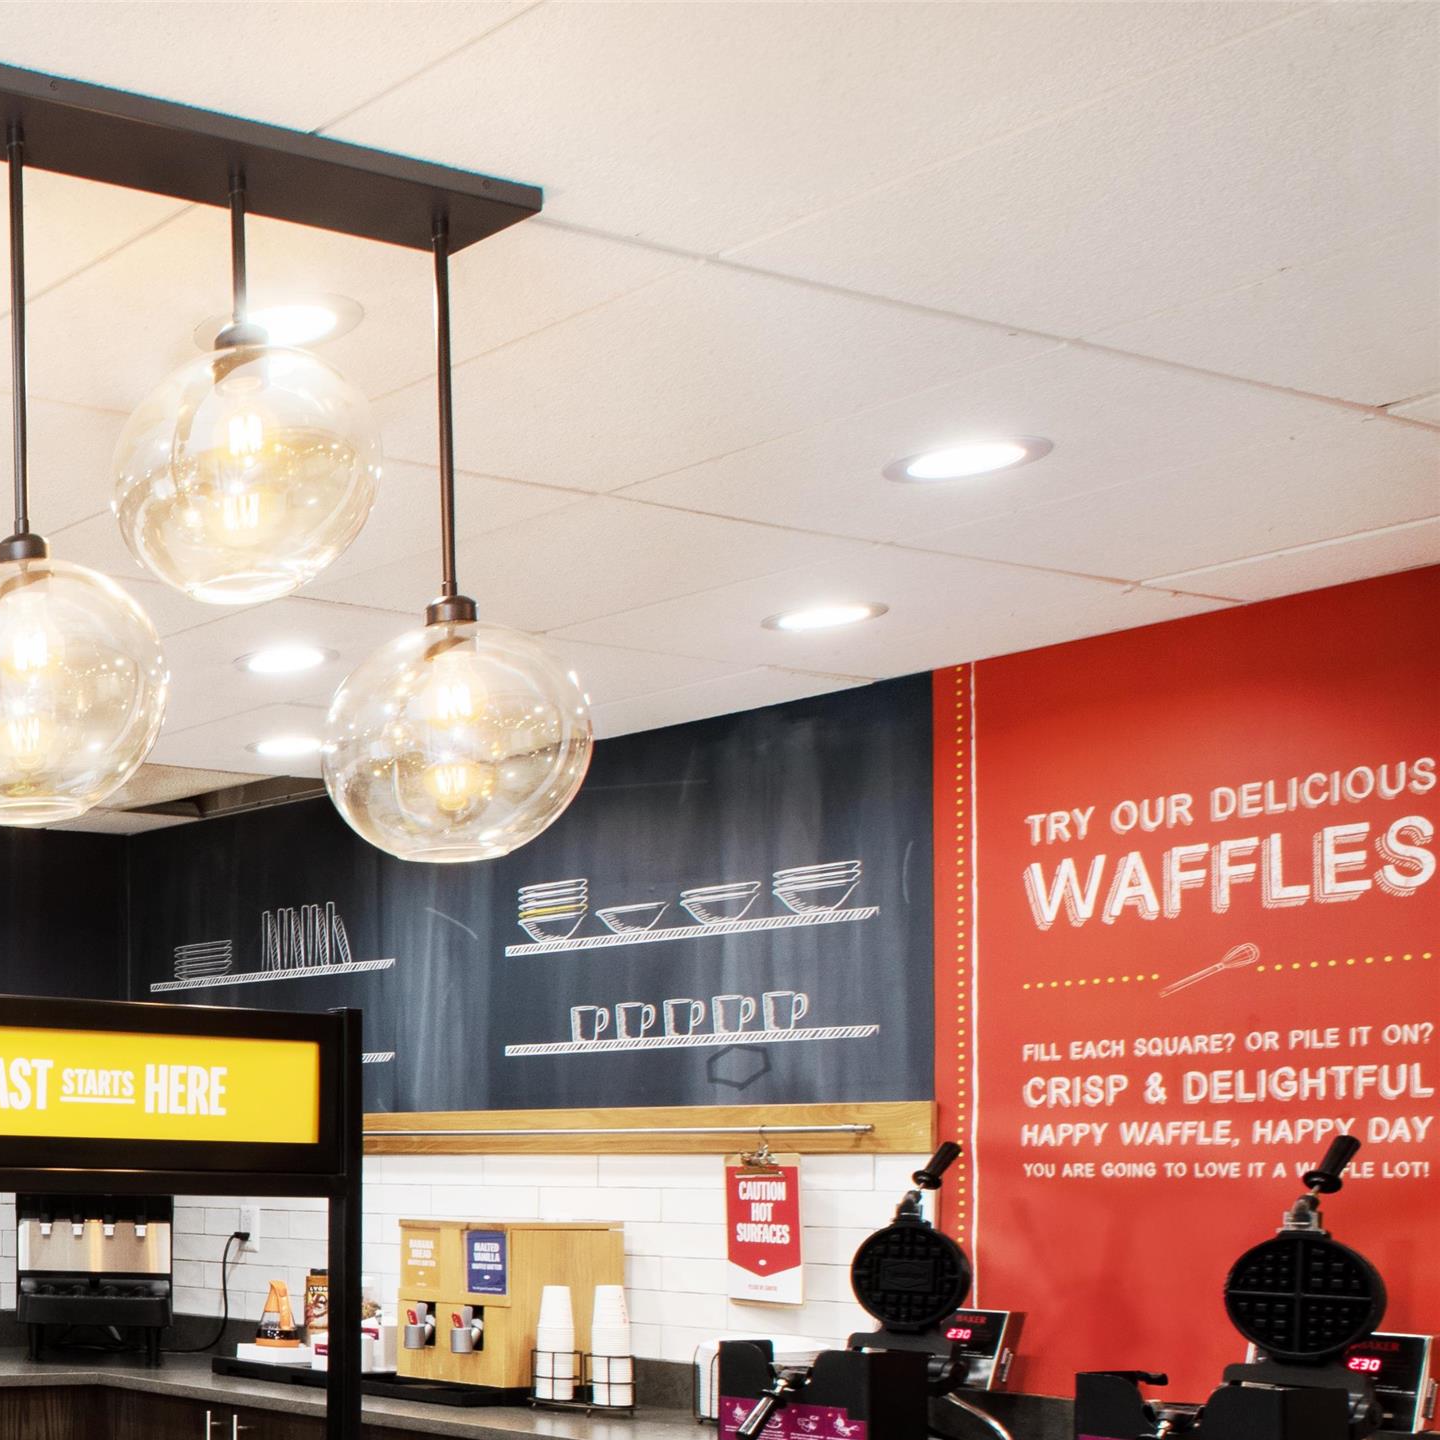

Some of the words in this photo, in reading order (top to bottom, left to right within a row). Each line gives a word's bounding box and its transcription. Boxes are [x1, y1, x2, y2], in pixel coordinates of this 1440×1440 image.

[1024, 805, 1095, 846] TRY
[1111, 793, 1193, 835] OUR
[1210, 757, 1437, 822] DELICIOUS
[1023, 815, 1437, 932] WAFFLES
[1023, 1042, 1062, 1062] FILL
[1070, 1039, 1125, 1060] EACH
[1133, 1033, 1236, 1057] SQUARE?
[1245, 1031, 1280, 1052] OR
[1289, 1027, 1340, 1050] PILE
[1349, 1026, 1373, 1047] IT
[1382, 1022, 1434, 1045] ON?
[60, 1067, 135, 1097] STARTS
[144, 1064, 228, 1116] HERE
[1023, 1074, 1129, 1108] CRISP
[1144, 1072, 1167, 1105] &
[1183, 1062, 1435, 1105] DELIGHTFUL
[1021, 1122, 1109, 1147] HAPPY
[1120, 1119, 1240, 1148] WAFFLE,
[1252, 1117, 1356, 1145] HAPPY
[1367, 1115, 1434, 1144] DAY
[1024, 1162, 1056, 1178] YOU
[1062, 1162, 1096, 1178] ARE
[1101, 1162, 1157, 1178] GOING
[1164, 1162, 1187, 1178] TO
[1194, 1162, 1240, 1178] LOVE
[1248, 1162, 1266, 1178] IT
[1272, 1162, 1287, 1178] A
[1382, 1161, 1430, 1179] LOT!
[738, 1181, 787, 1201] CAUTION
[750, 1202, 774, 1222] HOT
[736, 1222, 790, 1245] SURFACES
